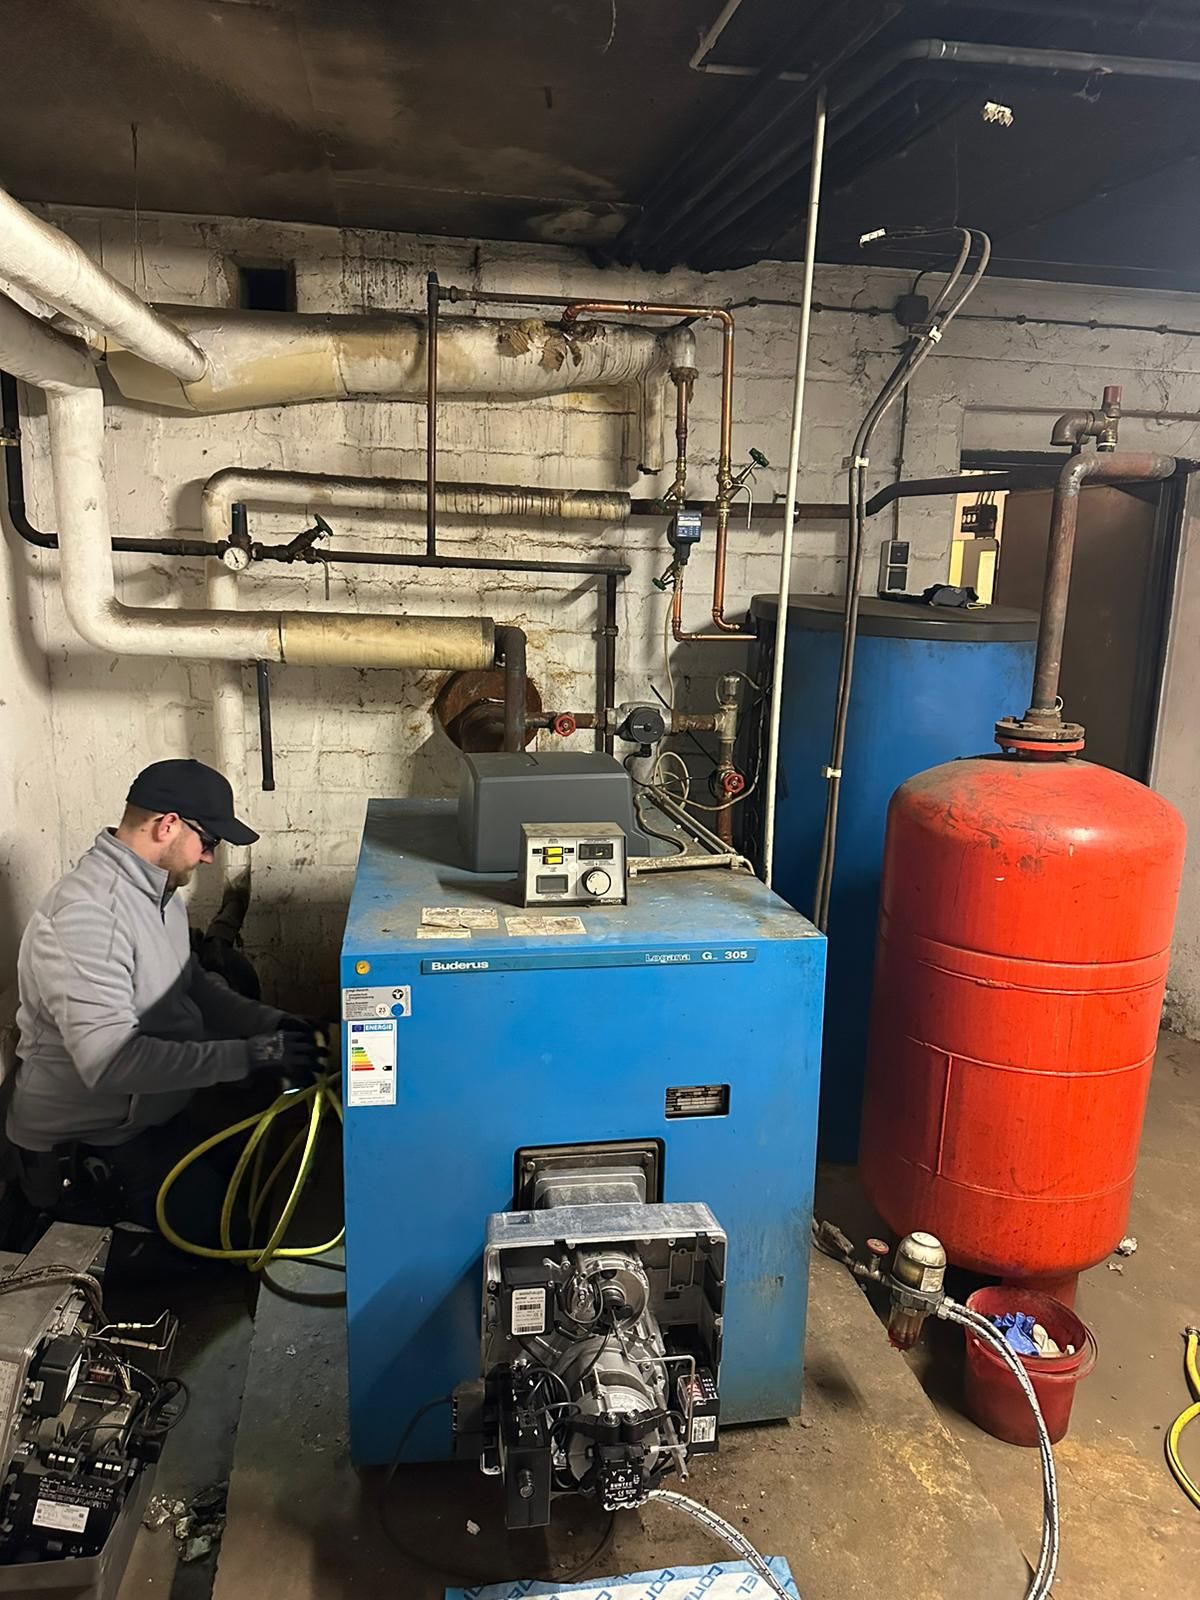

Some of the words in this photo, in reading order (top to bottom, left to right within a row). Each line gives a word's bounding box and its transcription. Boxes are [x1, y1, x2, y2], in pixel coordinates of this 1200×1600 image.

[645, 953, 691, 963] Logana
[724, 950, 748, 959] 305
[431, 961, 489, 970] Buderus
